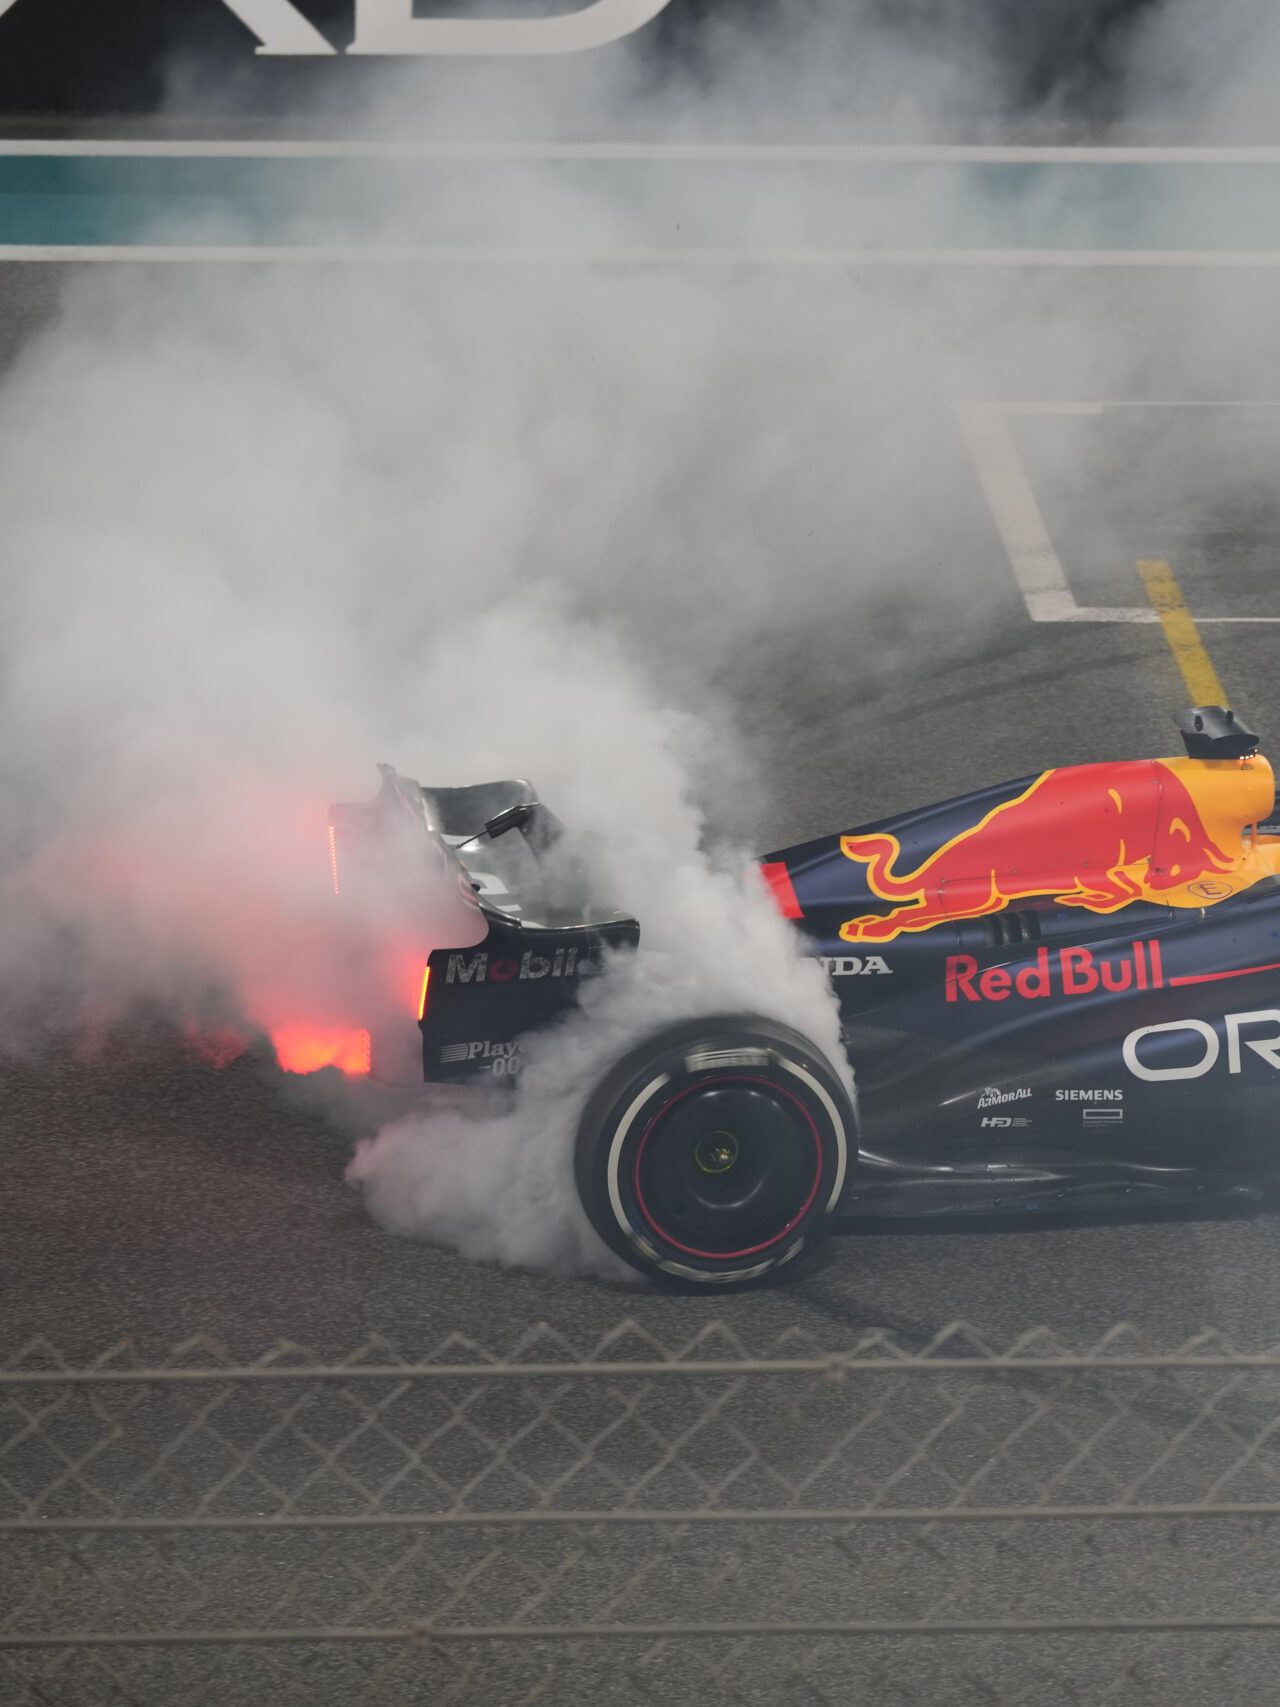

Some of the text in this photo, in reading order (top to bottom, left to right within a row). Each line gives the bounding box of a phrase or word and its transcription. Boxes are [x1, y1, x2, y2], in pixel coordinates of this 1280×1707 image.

[445, 947, 578, 985] Mobil
[810, 956, 893, 976] NDA
[945, 940, 1163, 1002] Red Bull
[466, 1038, 528, 1060] Playe
[1055, 1089, 1123, 1101] SIEMENS
